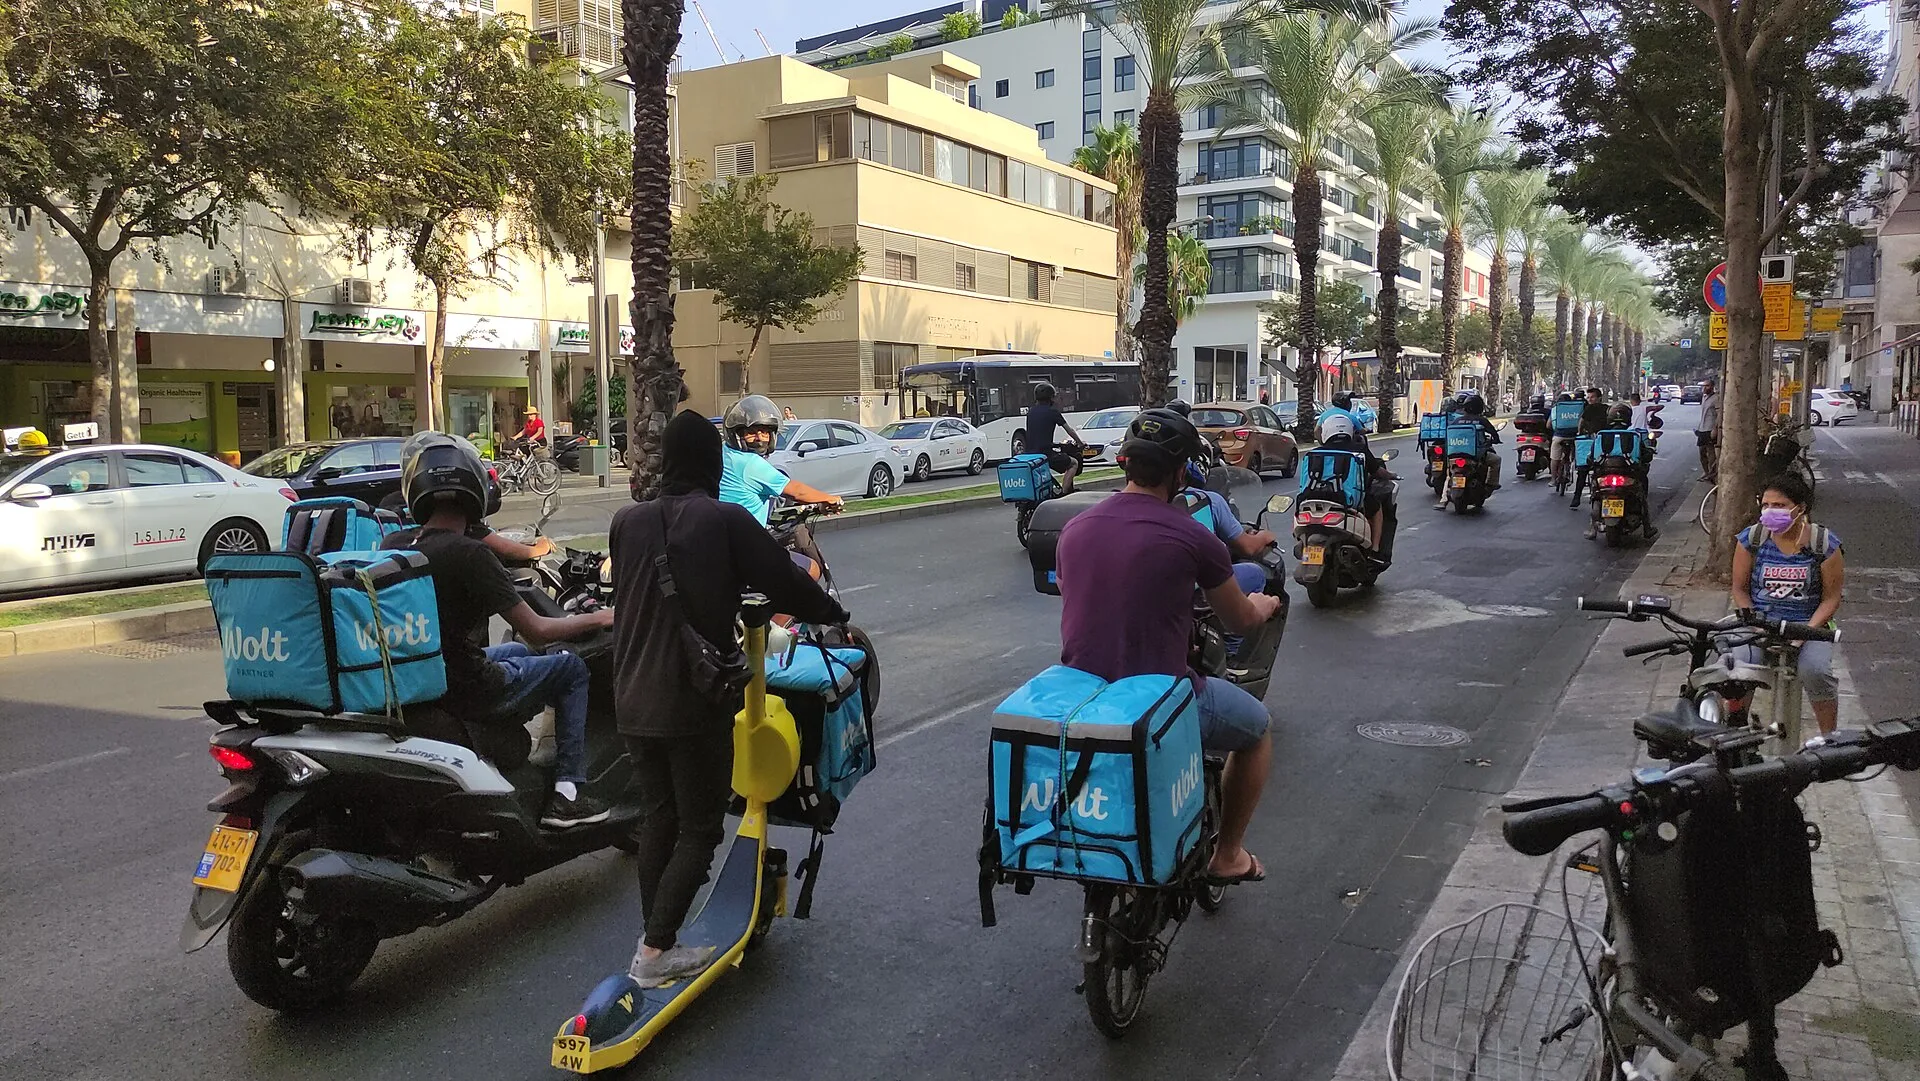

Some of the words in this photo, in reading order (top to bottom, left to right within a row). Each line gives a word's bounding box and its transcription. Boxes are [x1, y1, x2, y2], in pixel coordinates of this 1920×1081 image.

[140, 388, 165, 398] Organic
[166, 388, 202, 397] Healthstore
[1561, 412, 1580, 420] Wolt
[66, 431, 85, 441] Gett
[1450, 437, 1469, 446] Wolt
[1004, 477, 1026, 489] Wolt
[41, 533, 95, 551] מונית
[1764, 566, 1808, 580] LUCKY
[355, 612, 432, 651] Wolt
[221, 625, 290, 662] Wolt
[236, 667, 275, 678] PARTNER
[1171, 752, 1199, 817] Wolt
[1020, 778, 1109, 821] Wlt
[212, 854, 236, 873] 702
[558, 1038, 587, 1052] 597
[560, 1054, 583, 1071] 4W
